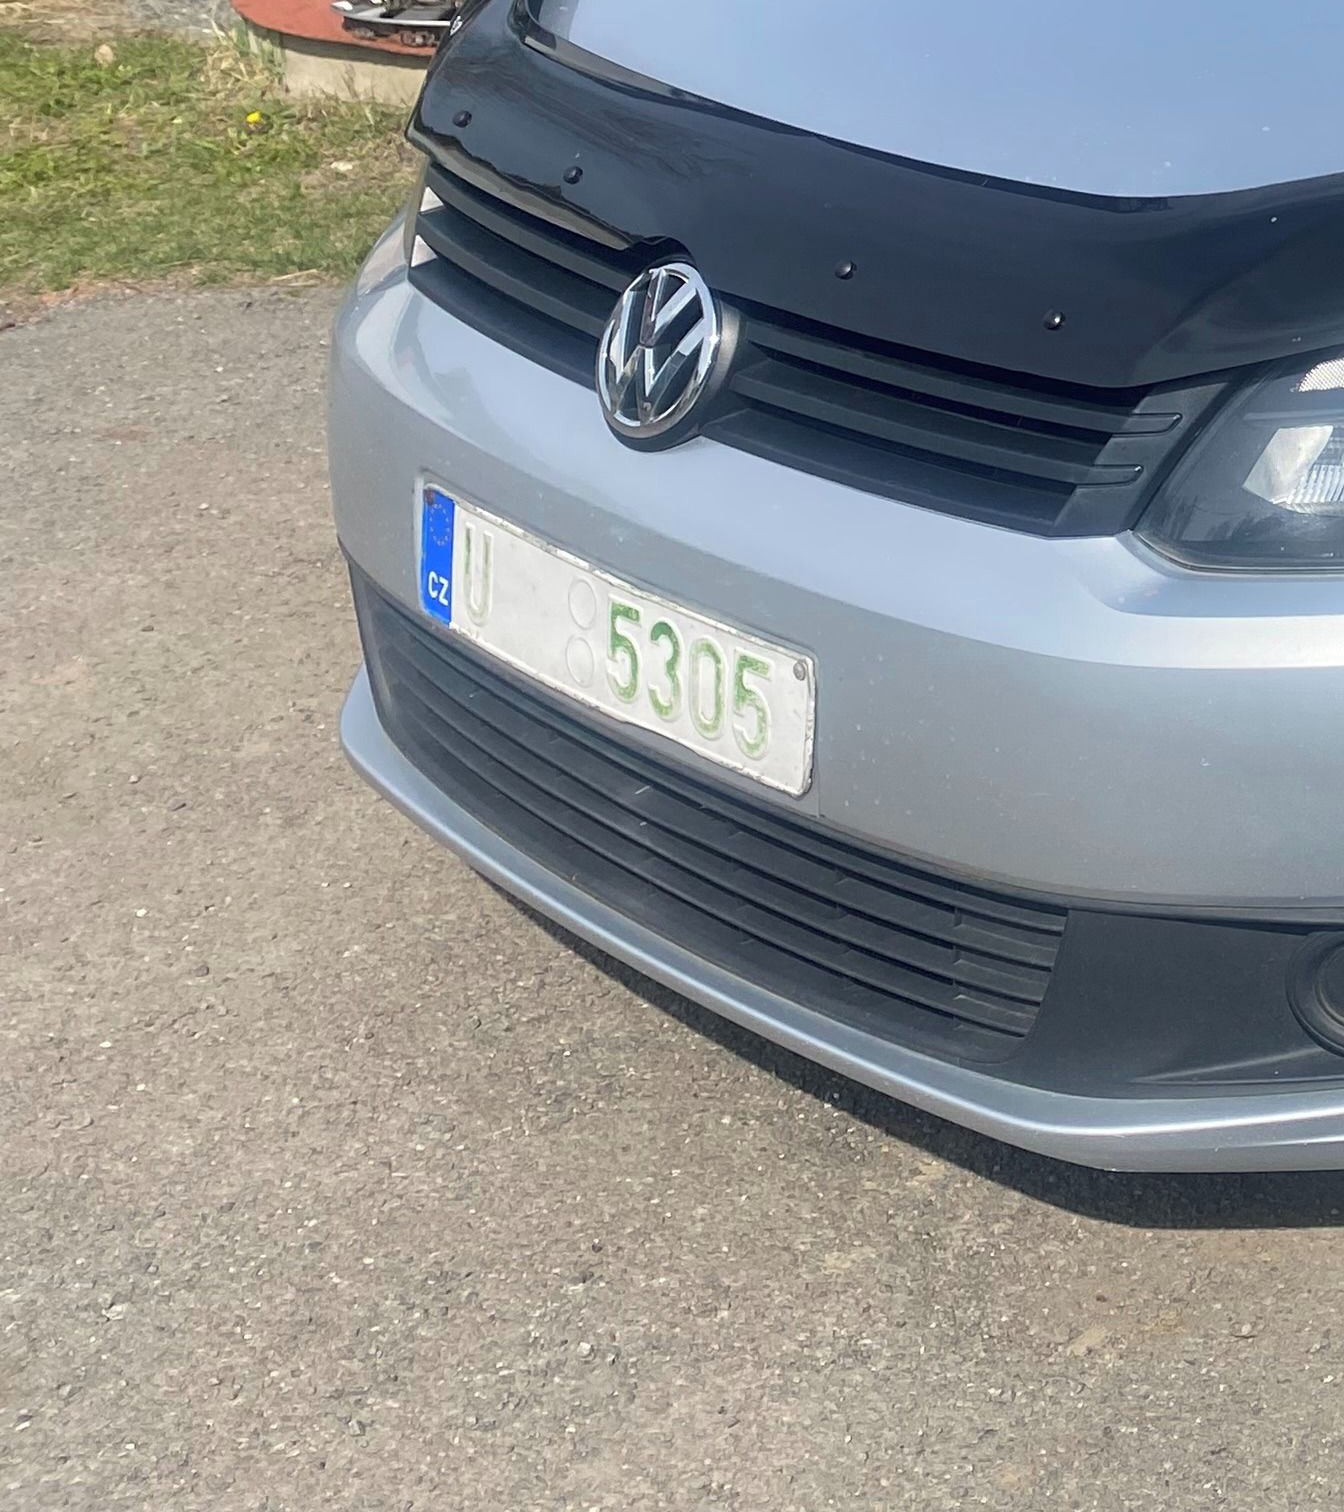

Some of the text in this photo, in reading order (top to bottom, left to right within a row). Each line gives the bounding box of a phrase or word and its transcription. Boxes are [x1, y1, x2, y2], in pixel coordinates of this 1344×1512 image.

[597, 262, 718, 438] VW
[428, 570, 449, 606] CZ
[606, 593, 773, 761] 5305
